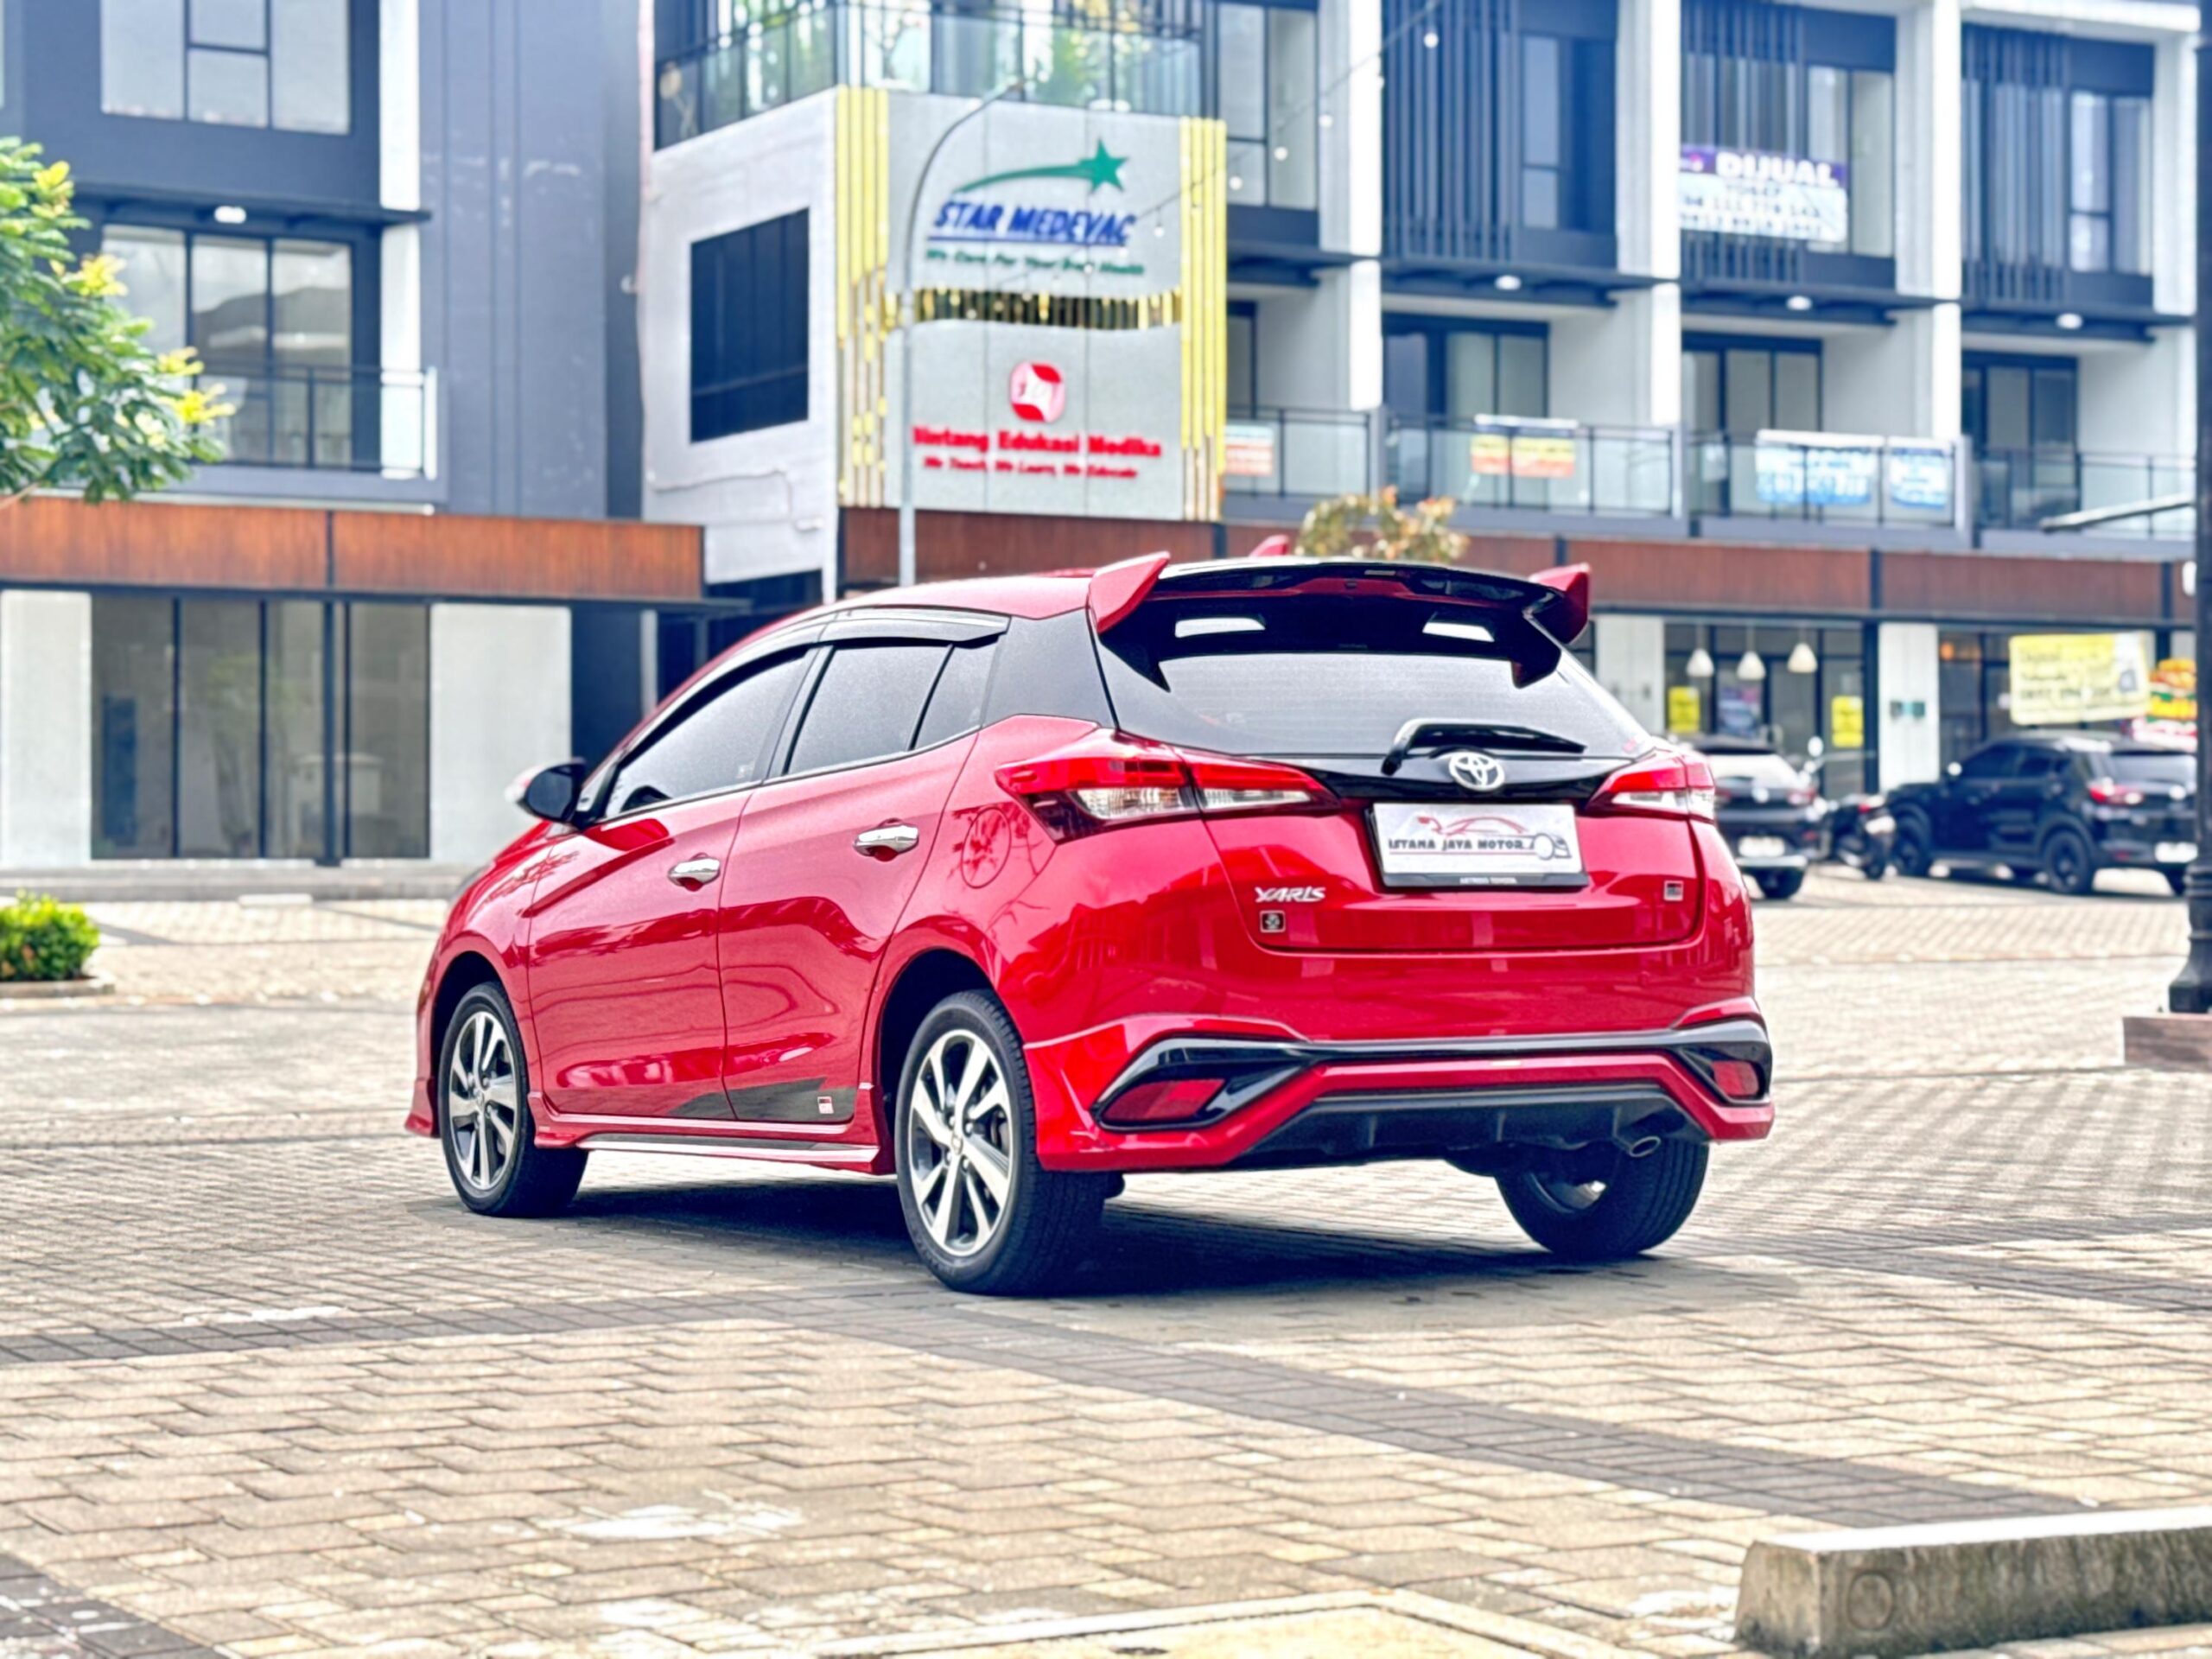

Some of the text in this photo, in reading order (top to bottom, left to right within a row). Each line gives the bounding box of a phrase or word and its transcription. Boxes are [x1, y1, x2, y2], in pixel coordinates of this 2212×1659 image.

[933, 200, 1137, 246] STAR MEDEVAC
[998, 430, 1080, 453] Edukasi
[1478, 839, 1523, 849] MOTOR
[1255, 886, 1326, 903] YARIS
